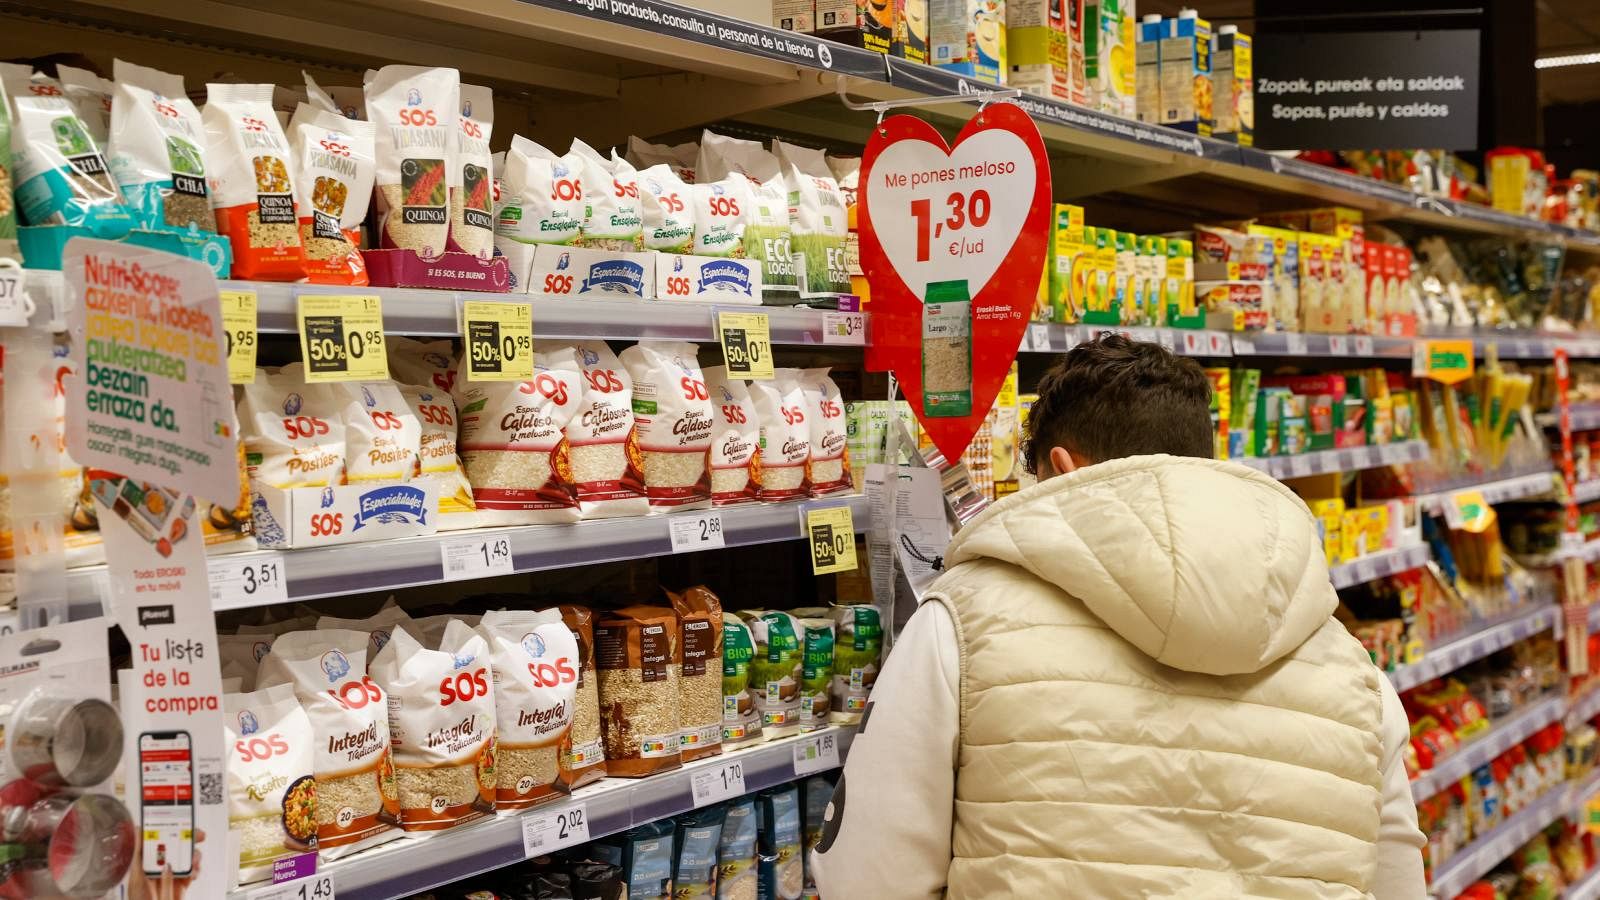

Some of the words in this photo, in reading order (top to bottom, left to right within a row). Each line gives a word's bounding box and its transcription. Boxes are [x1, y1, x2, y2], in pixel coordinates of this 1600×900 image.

[611, 0, 662, 25] producto,
[663, 13, 705, 35] consulta
[707, 23, 717, 37] al
[720, 27, 760, 47] personal
[761, 35, 774, 49] de
[775, 35, 785, 52] la
[785, 41, 815, 59] tienda
[1258, 78, 1313, 95] Zopak,
[1315, 77, 1372, 95] pureak
[1376, 77, 1404, 92] eta
[1408, 75, 1464, 91] saldak
[399, 108, 437, 126] SOS
[1272, 103, 1327, 120] Sopas,
[1329, 103, 1374, 120] purés
[1378, 106, 1388, 120] y
[1391, 103, 1448, 118] caldos
[885, 174, 907, 188] Me
[912, 167, 955, 190] pones
[959, 161, 1015, 179] meloso
[176, 178, 205, 195] CHIA
[551, 179, 582, 201] SOS
[260, 197, 293, 209] QUINOA
[261, 207, 293, 216] INTEGRAL
[659, 193, 685, 214] OS
[710, 196, 740, 216] SOS
[405, 210, 445, 222] QUINOA
[467, 213, 492, 227] QUINO
[911, 189, 991, 262] 1,30
[949, 237, 984, 258] €/ud
[434, 269, 442, 277] ES
[443, 270, 457, 279] SOS,
[458, 271, 465, 279] ES
[466, 271, 486, 280] BUENO
[544, 273, 574, 294] SOS
[591, 266, 641, 282] Especialidades
[703, 266, 749, 282] Especialidades
[667, 277, 690, 295] SOS
[928, 323, 947, 333] Largo
[310, 338, 346, 361] 50%
[348, 331, 381, 359] 0,95
[472, 341, 501, 361] 50%
[503, 335, 530, 362] 0,95
[727, 346, 749, 363] 50%
[749, 341, 768, 363] 0,71
[86, 336, 187, 382] aukeratzea
[87, 357, 149, 398] bezain
[583, 369, 624, 393] SOS
[519, 373, 568, 406] SOS
[681, 376, 710, 401] SO
[86, 388, 145, 423] erraza
[151, 400, 180, 433] da.
[418, 404, 453, 426] SOS
[721, 404, 747, 424] SOS
[282, 416, 330, 440] SOS
[592, 428, 599, 437] y
[673, 417, 712, 436] Caldoso
[510, 432, 517, 443] y
[362, 492, 422, 513] Especialidades
[310, 513, 344, 537] SOS
[699, 517, 721, 541] 2,68
[481, 540, 508, 566] 1,43
[815, 541, 835, 558] 50%
[133, 569, 153, 579] Todo
[156, 567, 186, 578] EROSKI
[242, 564, 278, 593] 3,51
[135, 585, 147, 593] en
[148, 584, 157, 592] tu
[157, 582, 181, 591] móvil
[140, 643, 161, 661] Tu
[165, 638, 204, 664] lista
[685, 650, 706, 658] Integral
[727, 648, 747, 660] BIO
[809, 652, 827, 663] BIO
[143, 669, 167, 687] de
[172, 668, 190, 686] la
[527, 657, 576, 688] SOS
[440, 667, 488, 707] SOS
[145, 695, 218, 715] compra
[517, 699, 566, 727] Integral
[328, 719, 378, 754] Integral
[428, 714, 476, 748] Integral
[235, 733, 289, 762] SOS
[347, 736, 383, 762] Tradicional
[447, 730, 483, 754] Tradicional
[816, 735, 833, 756] 1,65
[520, 780, 530, 789] 20
[721, 764, 741, 790] 1,70
[434, 799, 446, 808] 20
[340, 812, 351, 822] 20
[557, 809, 583, 840] 2,02
[274, 859, 296, 871] Berria
[274, 869, 297, 881] Nuevo
